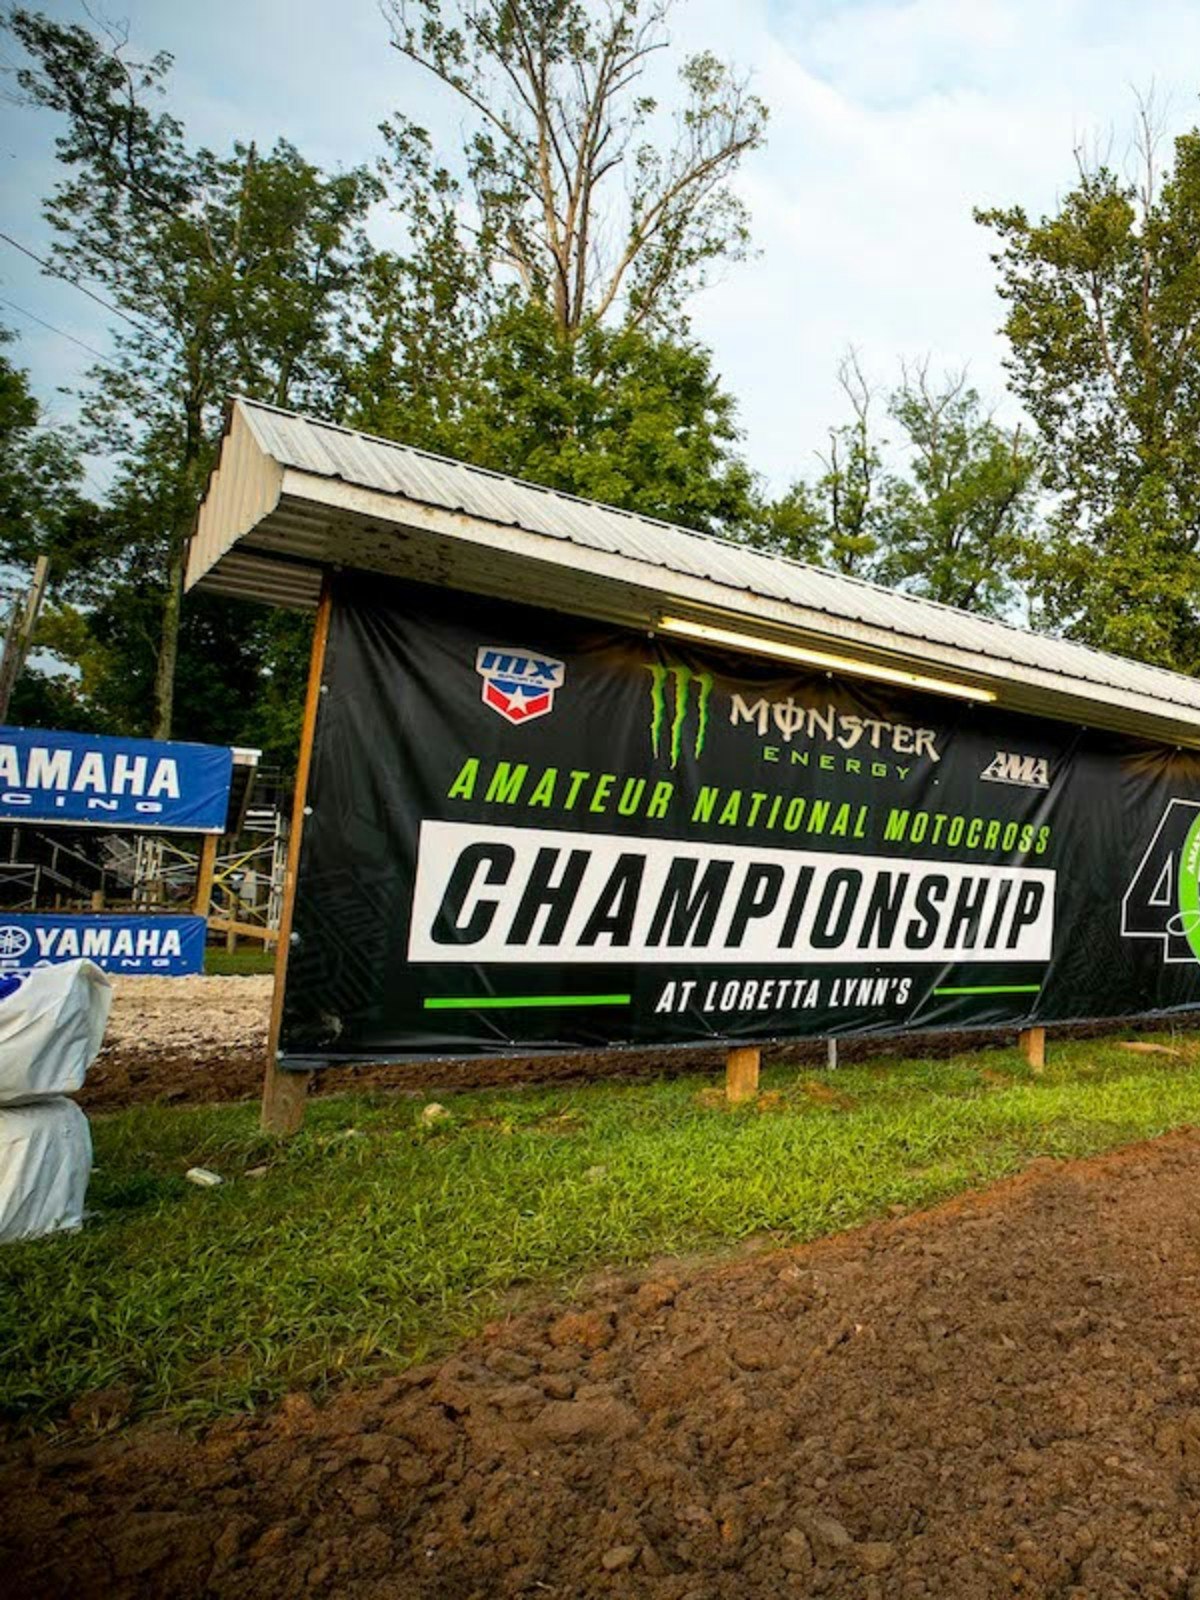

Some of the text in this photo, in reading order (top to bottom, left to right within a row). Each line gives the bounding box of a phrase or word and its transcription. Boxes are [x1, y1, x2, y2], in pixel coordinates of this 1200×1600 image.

[729, 693, 941, 763] MONSTER
[763, 746, 911, 780] ENERGY
[980, 751, 1050, 786] AMA
[447, 757, 1051, 855] AMATEUR NATIONAL MOTOCROSS
[430, 841, 1046, 949] CHAMPIONSHIP
[35, 928, 182, 957] YAMAHA
[654, 977, 912, 1013] AT LORETTA LYNN'S
